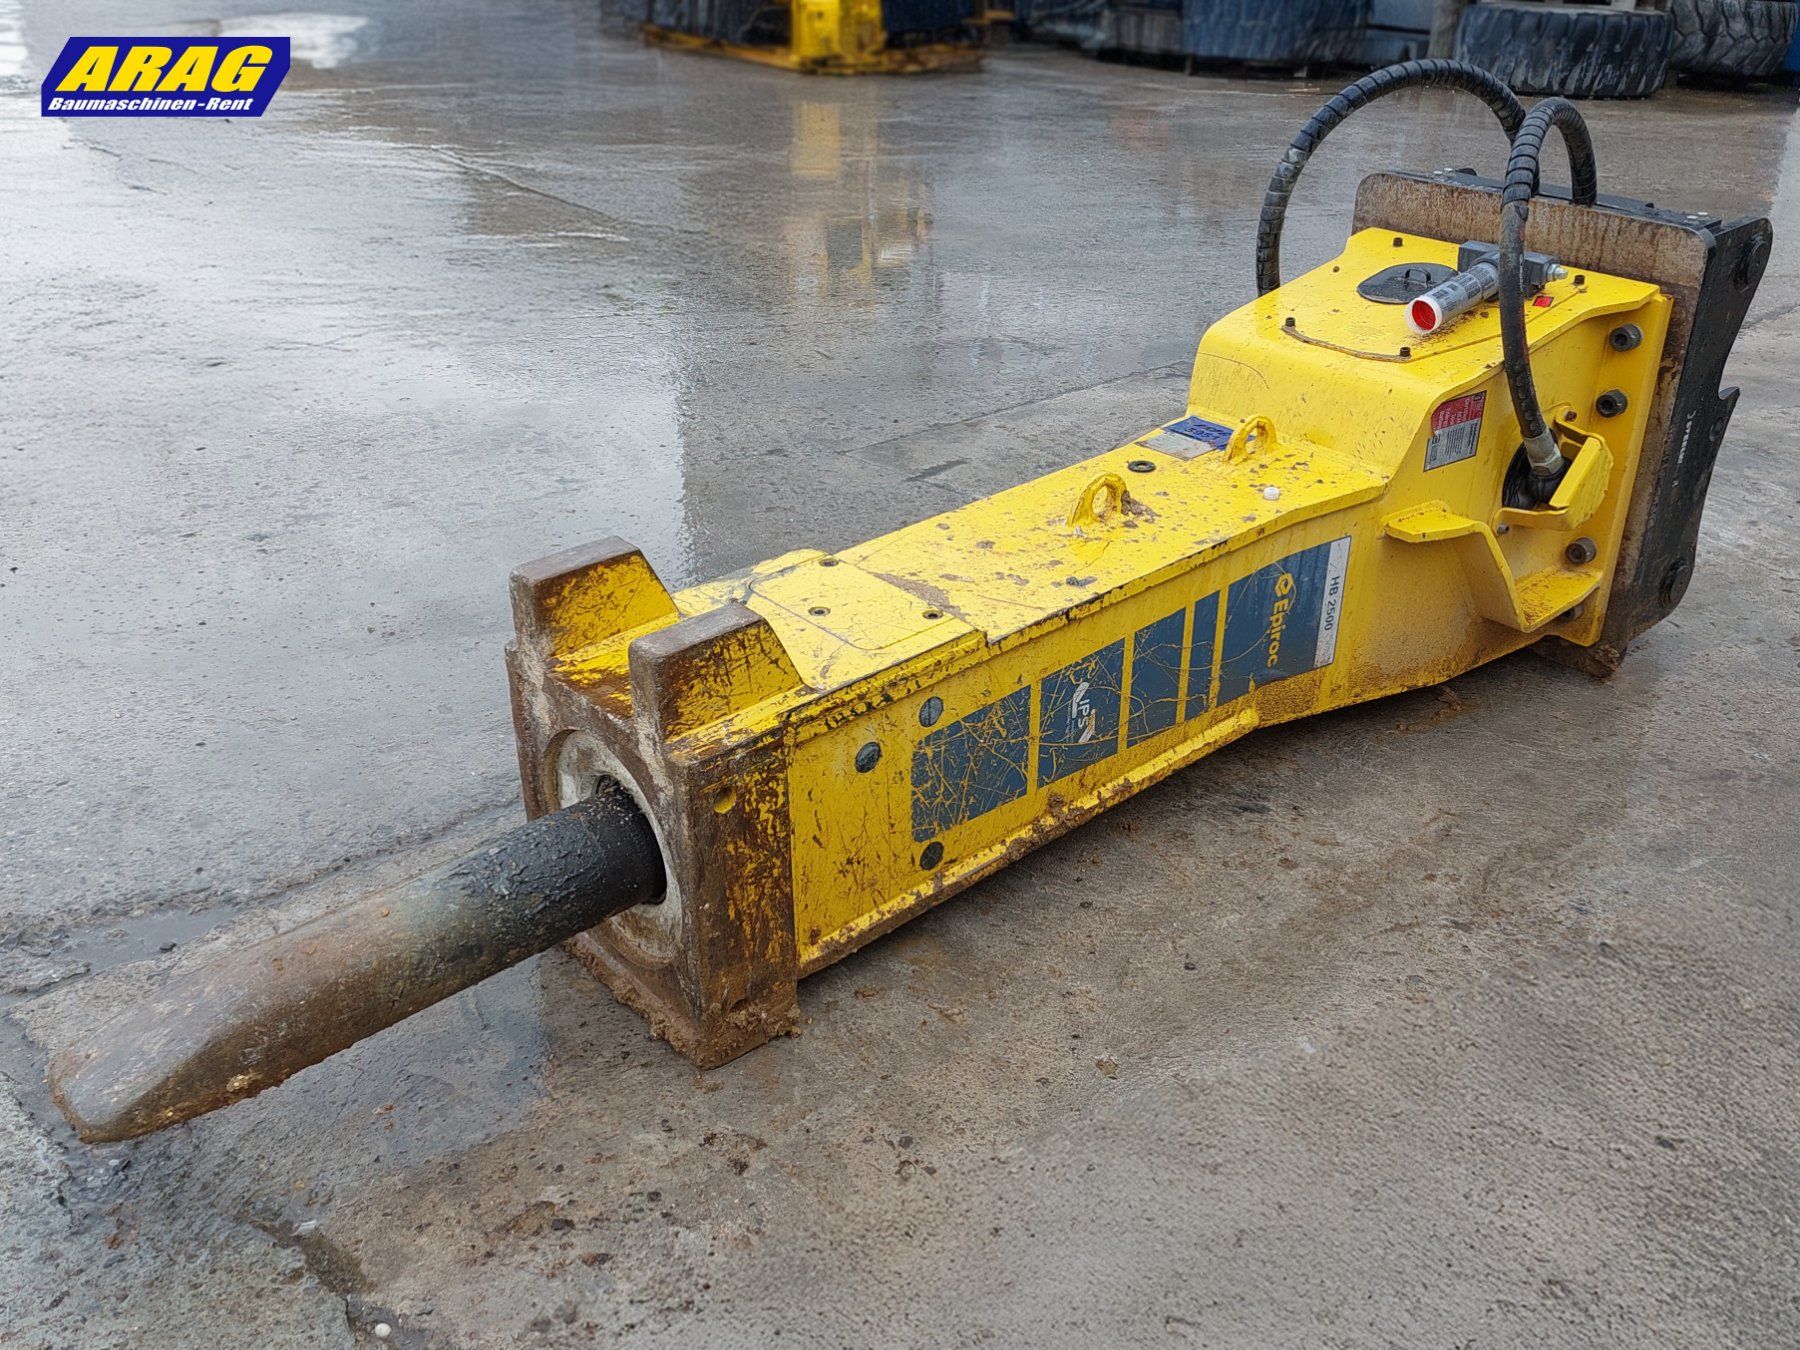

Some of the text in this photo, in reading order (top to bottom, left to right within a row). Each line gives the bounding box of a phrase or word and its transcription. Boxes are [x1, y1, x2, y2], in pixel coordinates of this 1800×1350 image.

[1266, 598, 1290, 668] Epiroc
[1324, 575, 1340, 631] HB 2500
